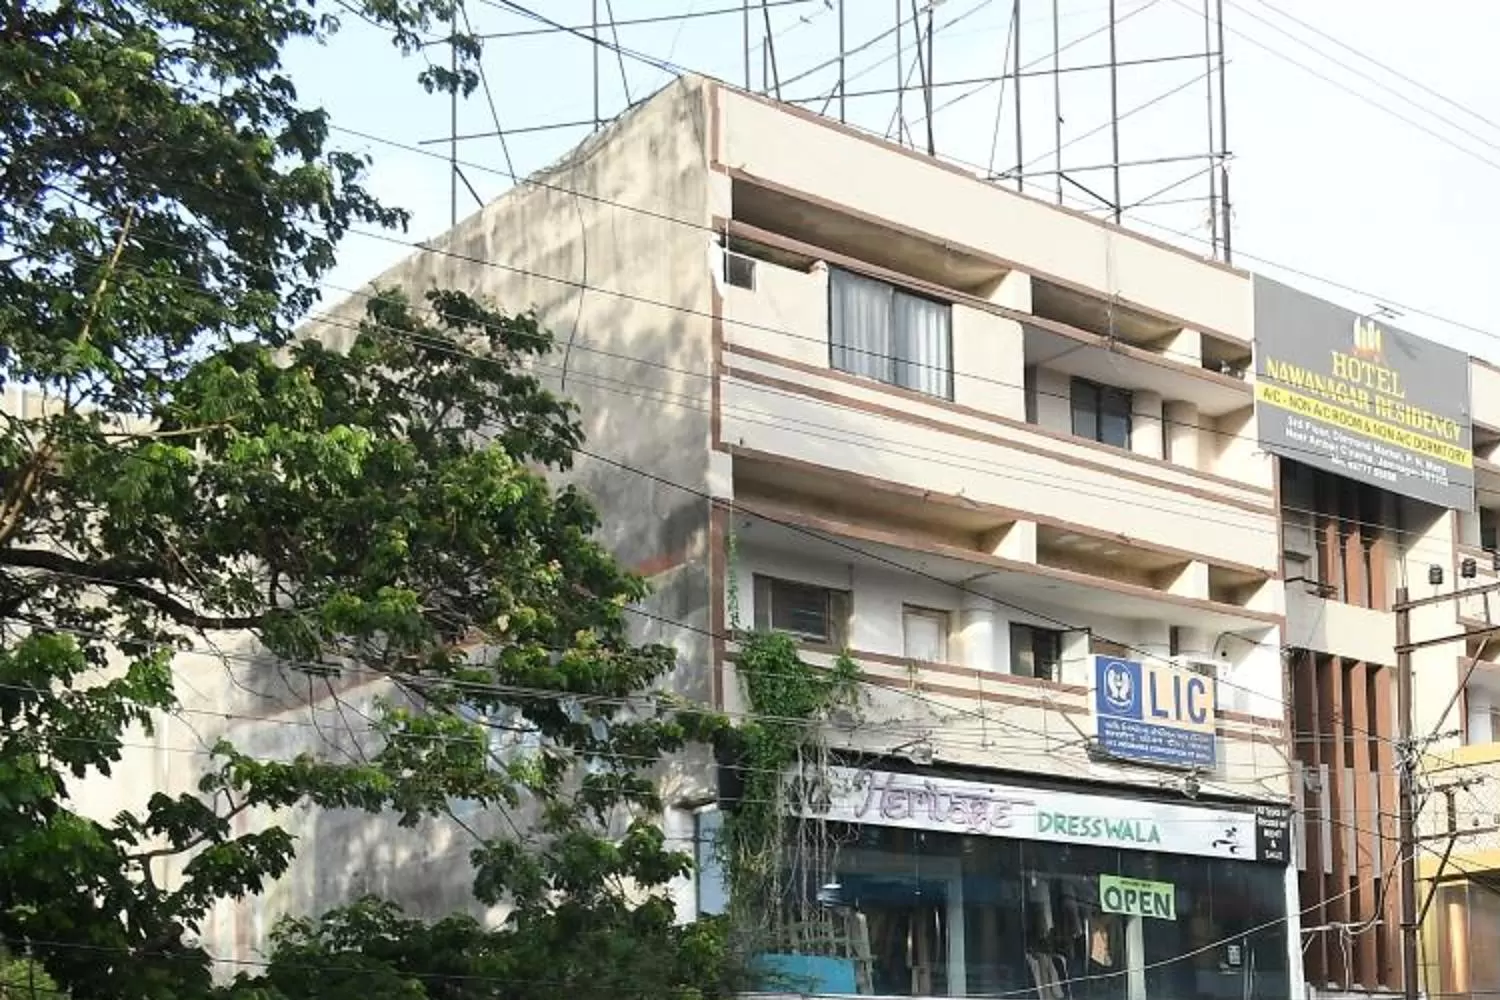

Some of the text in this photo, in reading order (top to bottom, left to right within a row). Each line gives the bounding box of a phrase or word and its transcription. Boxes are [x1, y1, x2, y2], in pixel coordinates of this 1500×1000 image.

[1331, 350, 1406, 399] HOTEL
[1375, 395, 1461, 441] RESIDENCY
[1149, 671, 1207, 724] LIC
[1104, 885, 1171, 917] OPEN
